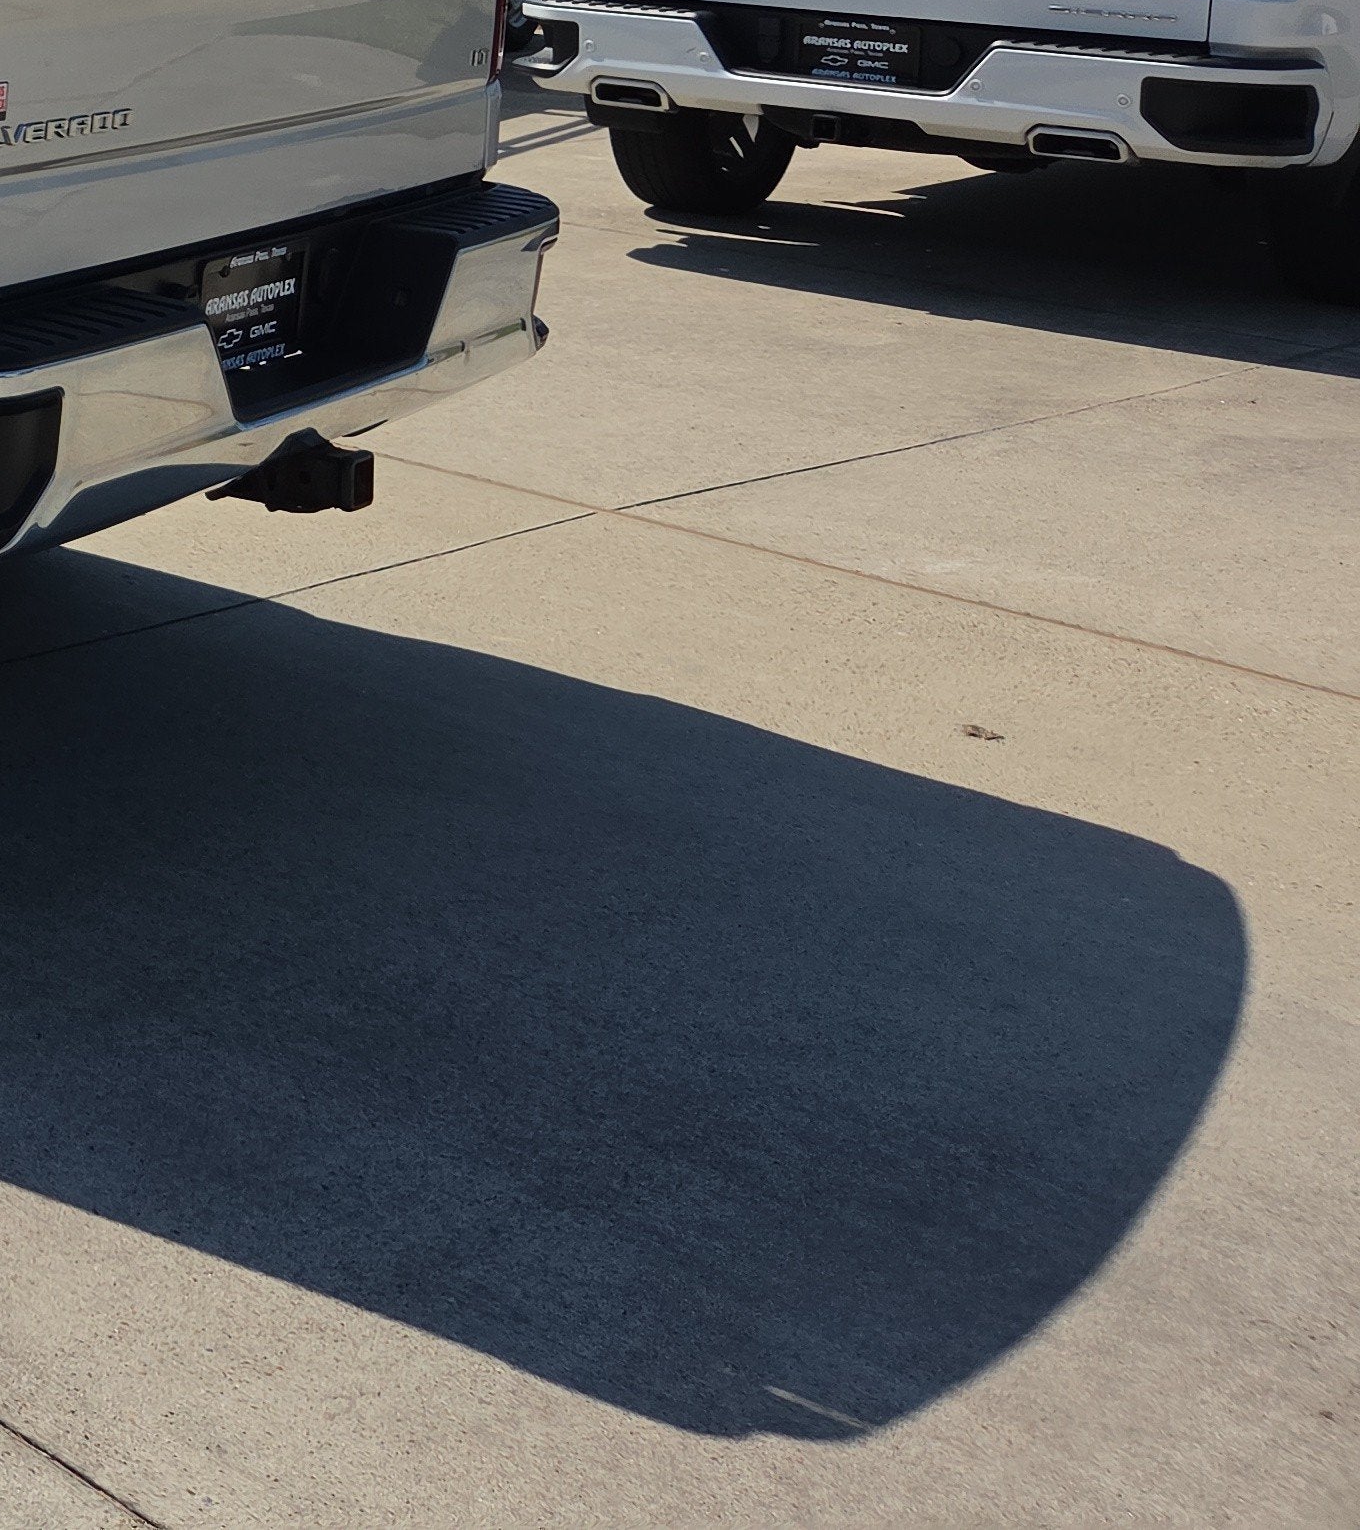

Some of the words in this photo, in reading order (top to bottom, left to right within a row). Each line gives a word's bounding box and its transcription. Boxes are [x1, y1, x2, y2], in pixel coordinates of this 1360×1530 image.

[804, 36, 851, 48] ARANSAS
[854, 41, 908, 53] AUTOPLEX
[857, 59, 888, 69] GMC
[206, 290, 249, 316] ARANSAS
[250, 278, 295, 305] AUTOPLEX
[250, 321, 277, 338] GMC
[246, 344, 285, 364] AUTOPLEX
